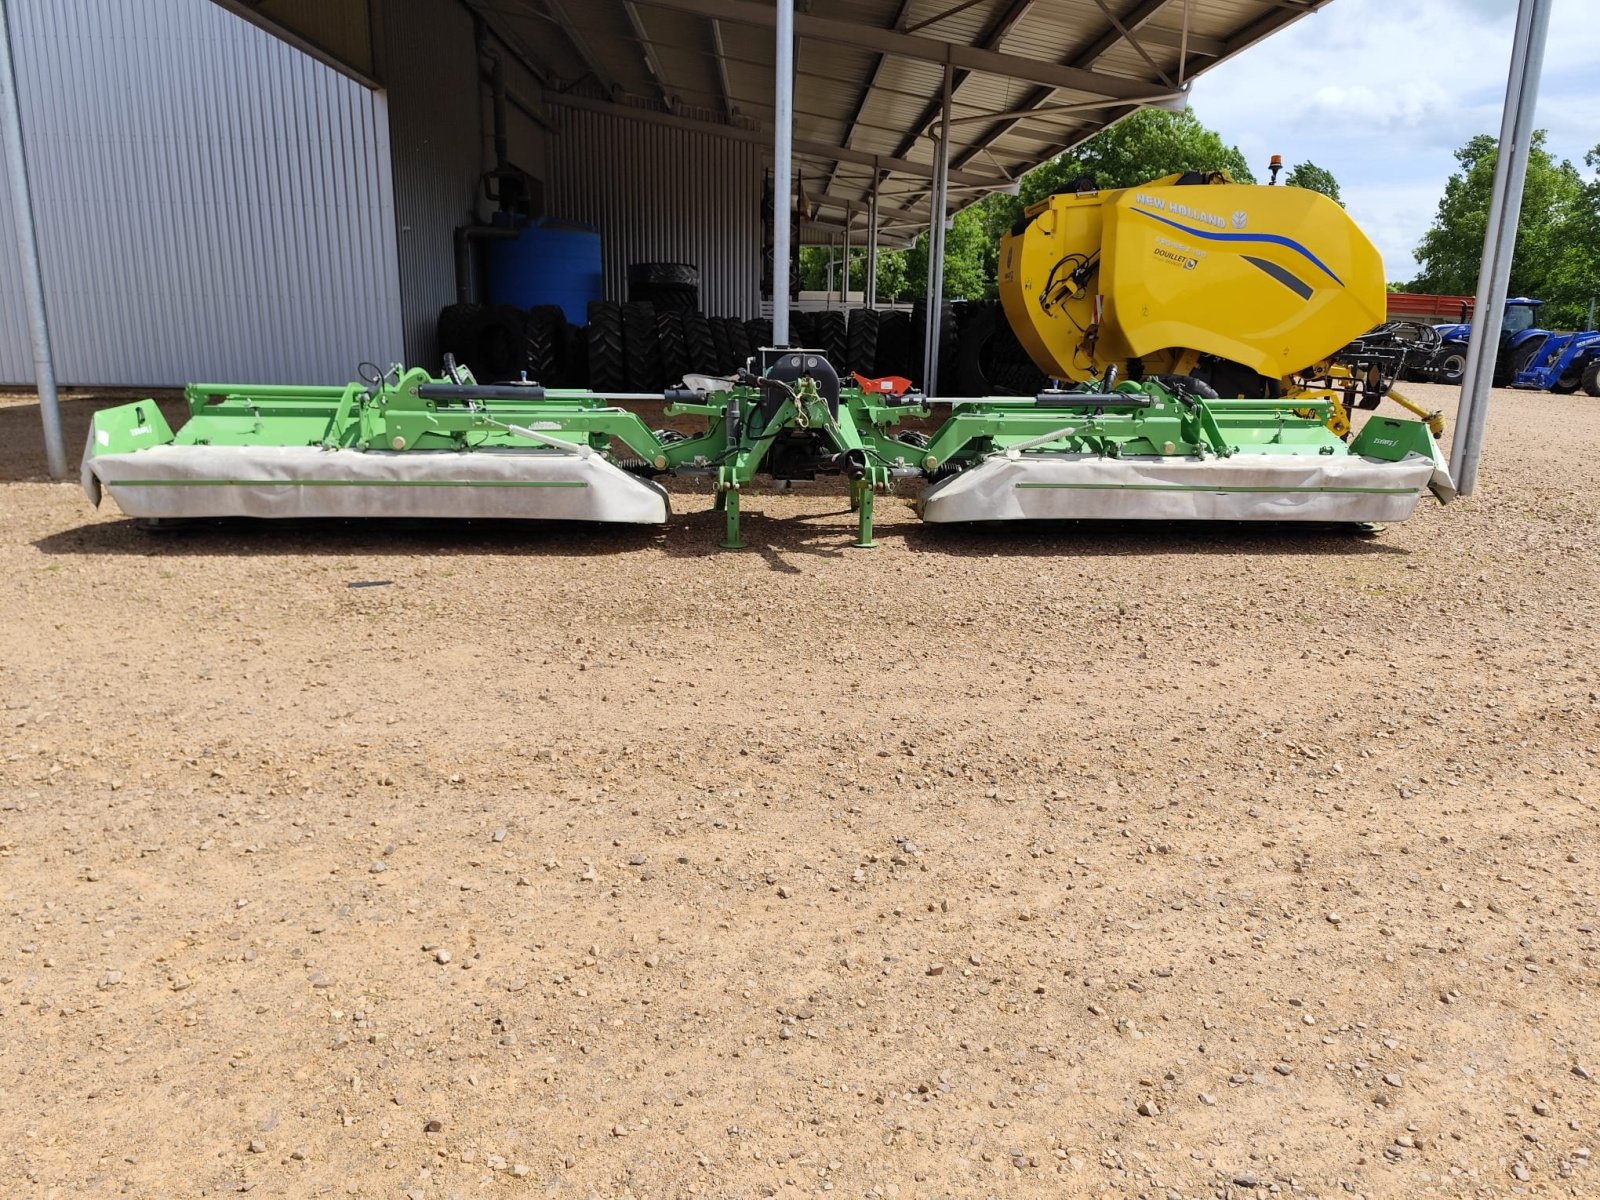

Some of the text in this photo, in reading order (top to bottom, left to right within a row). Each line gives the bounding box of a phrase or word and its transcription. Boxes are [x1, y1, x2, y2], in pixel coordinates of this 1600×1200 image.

[1136, 194, 1225, 228] NEW HOLLAND
[1154, 248, 1187, 263] DOUILLET
